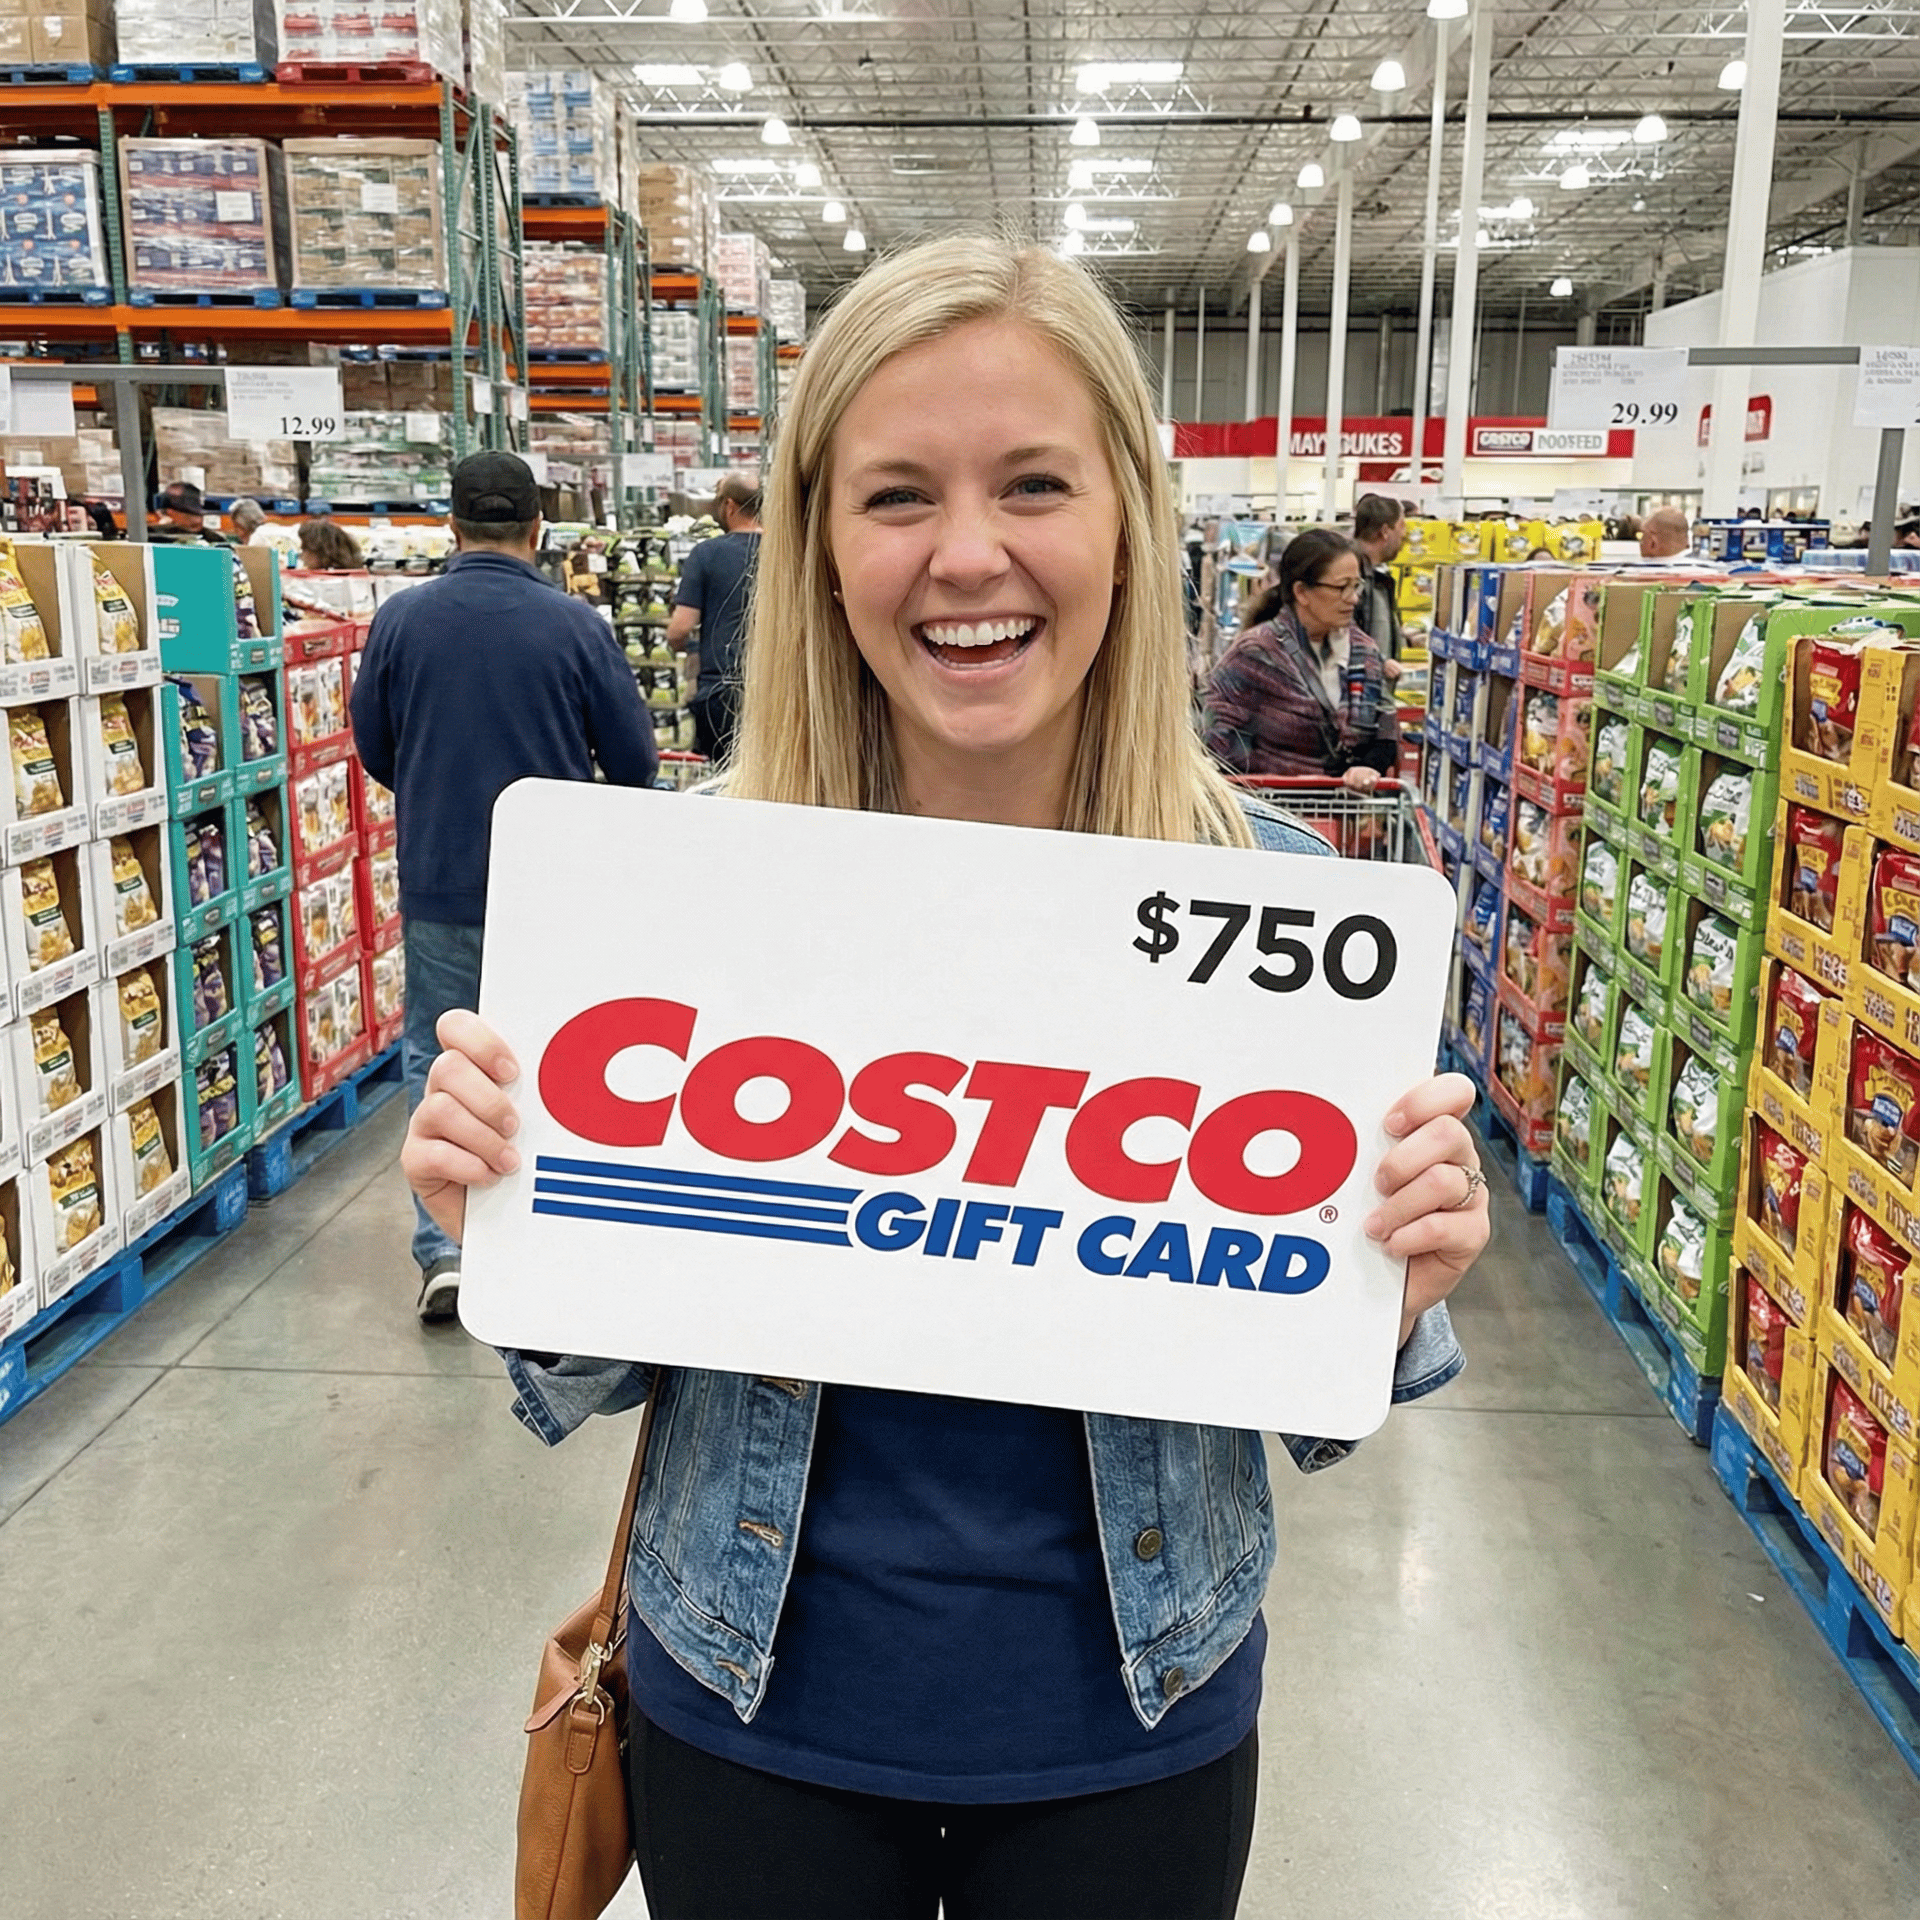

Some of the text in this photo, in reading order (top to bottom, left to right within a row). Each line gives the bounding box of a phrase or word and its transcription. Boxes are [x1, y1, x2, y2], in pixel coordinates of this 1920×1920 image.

[281, 416, 336, 436] 12.99
[1611, 402, 1678, 425] 29.99
[1133, 890, 1398, 1001] $750
[539, 997, 1358, 1216] COSTCO
[855, 1191, 1331, 1295] GIFT CARD
